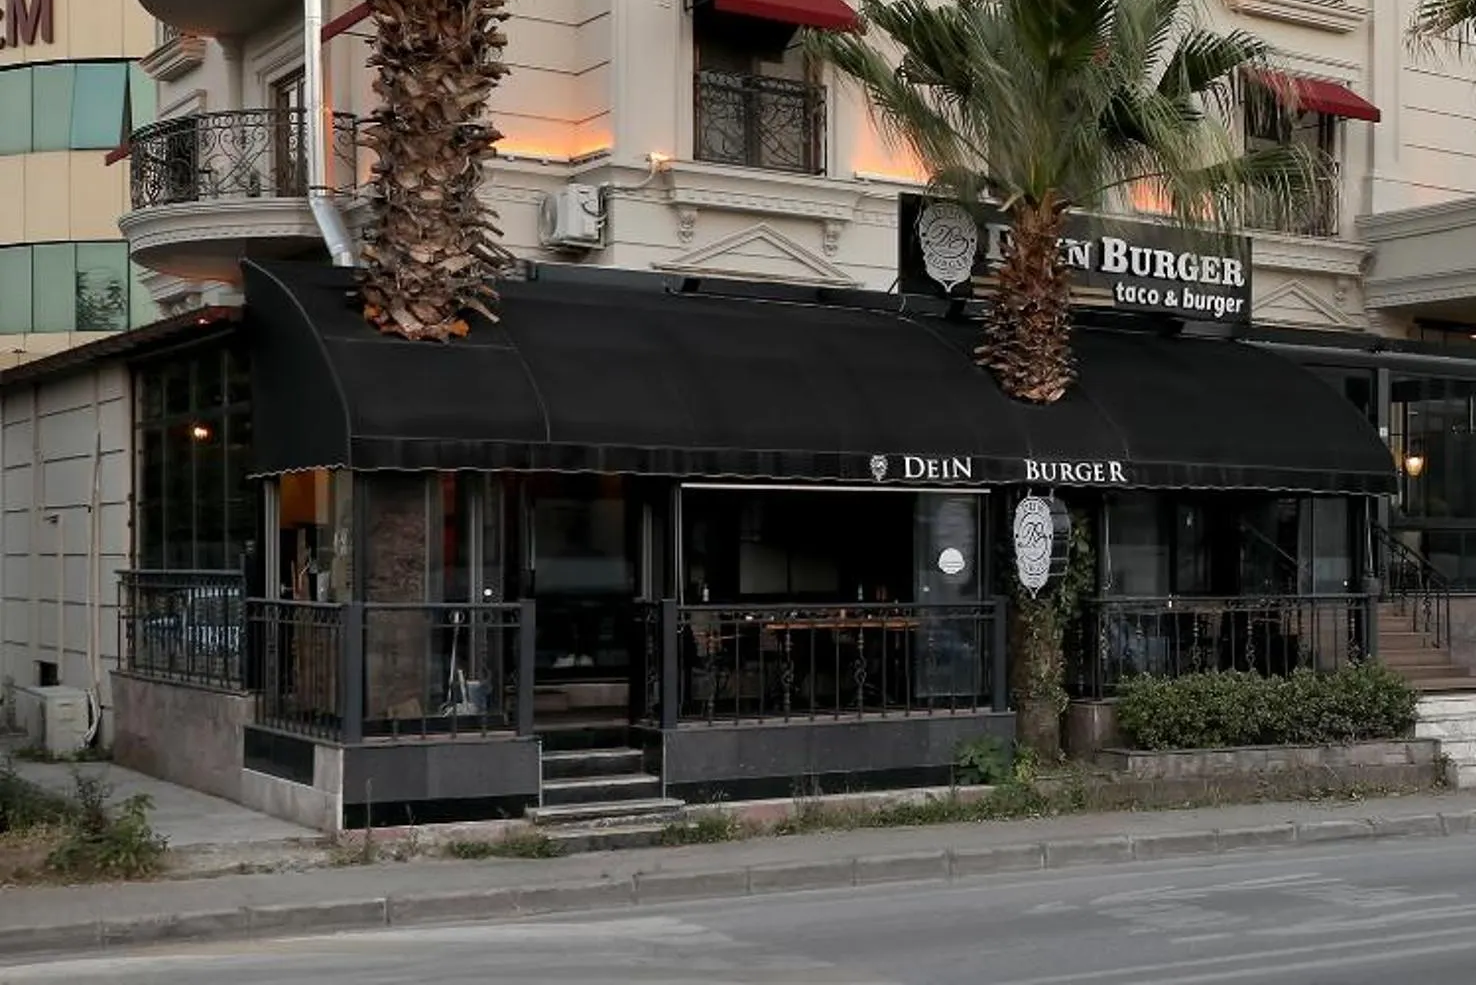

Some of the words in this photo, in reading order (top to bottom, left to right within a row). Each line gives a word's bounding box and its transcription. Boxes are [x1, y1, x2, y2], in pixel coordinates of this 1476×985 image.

[1101, 235, 1246, 288] BURGER
[1115, 281, 1159, 306] taco
[1164, 289, 1179, 308] &
[1182, 287, 1245, 318] burger
[903, 455, 973, 480] DEIN
[1024, 458, 1127, 483] BURGER
